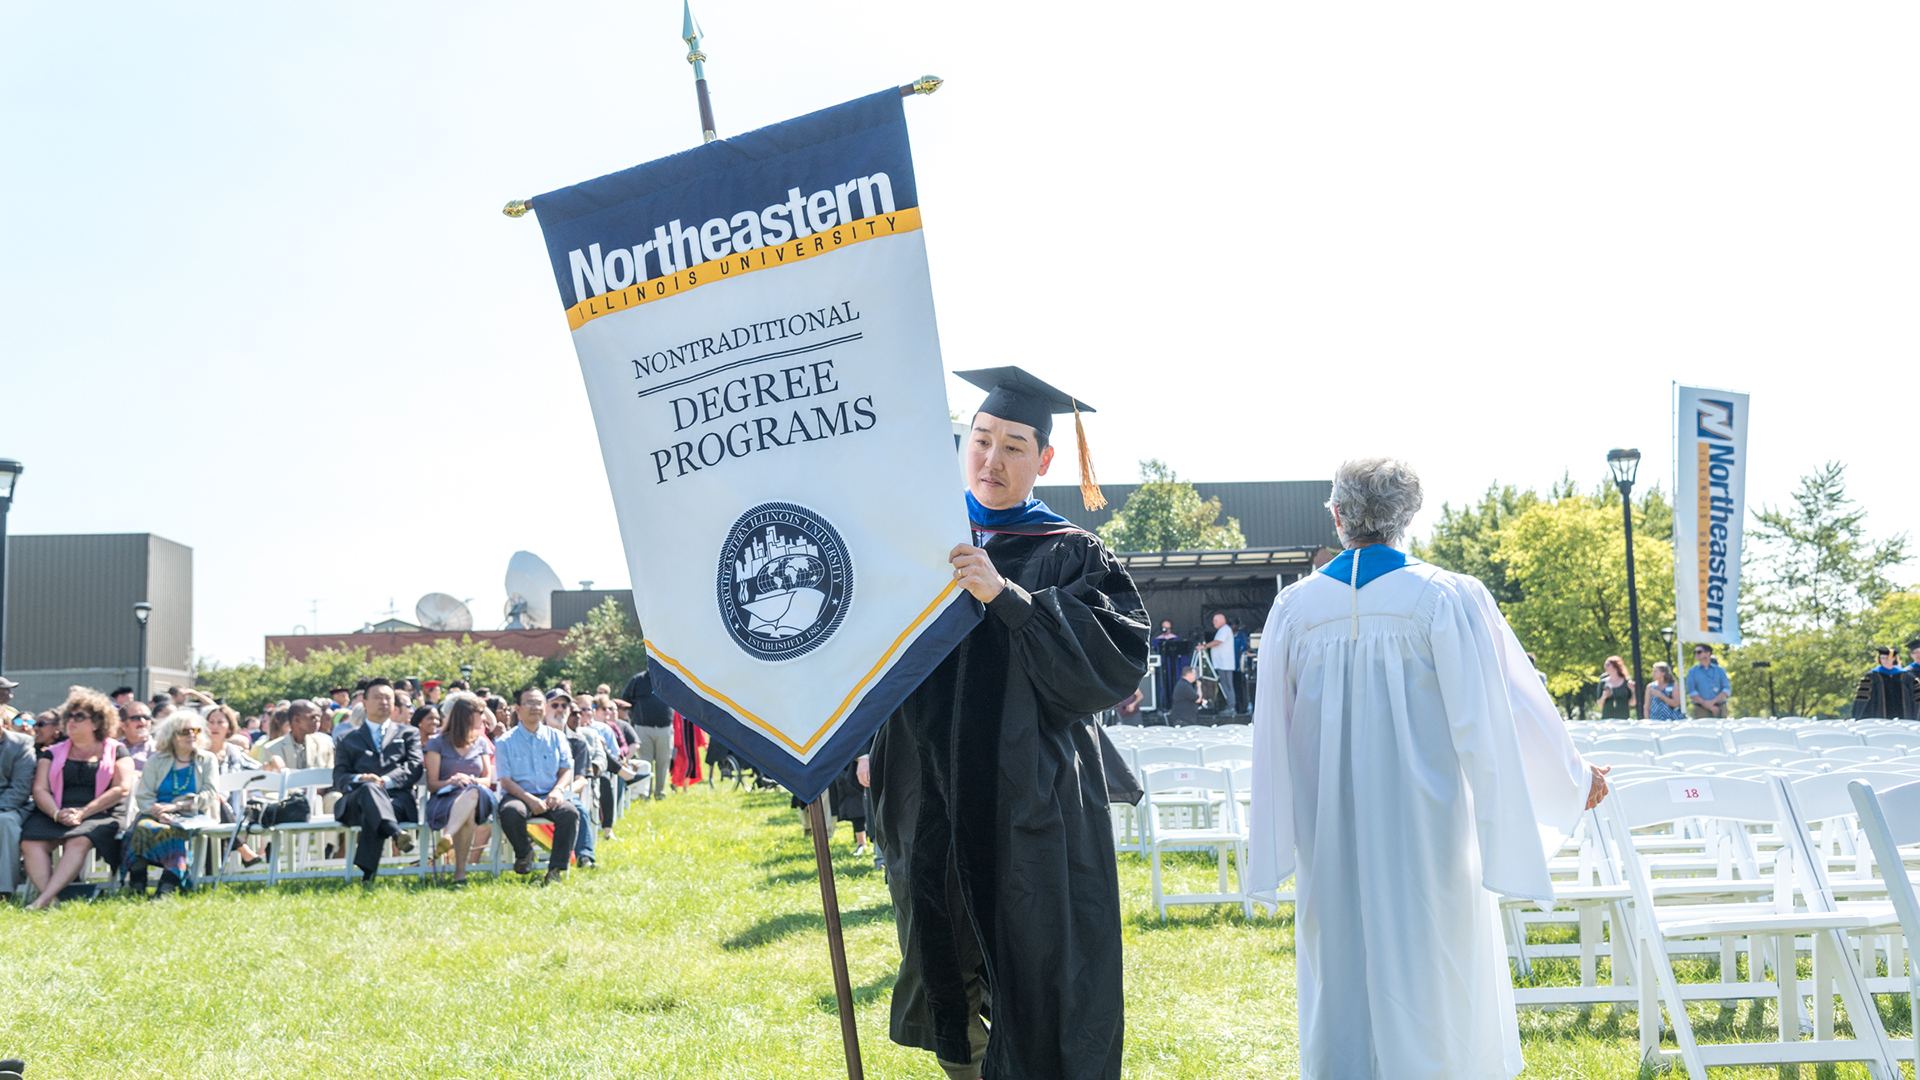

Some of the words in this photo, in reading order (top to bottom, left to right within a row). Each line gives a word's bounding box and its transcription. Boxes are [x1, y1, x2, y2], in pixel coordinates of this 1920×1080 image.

[568, 172, 896, 303] Northeastern
[578, 271, 698, 320] ILLINOIS
[720, 216, 897, 276] UNIVERSITY
[631, 301, 861, 380] NONTRADITIONAL
[650, 395, 877, 485] PROGRAMS
[669, 359, 839, 433] DEGREE
[722, 524, 750, 619] NORTHEASTERN
[750, 511, 800, 527] ILLINOIS
[803, 520, 843, 586] UNIVERSITY
[1707, 443, 1735, 634] Northeastern
[747, 635, 804, 651] ESTABLISHED
[805, 621, 824, 639] 1867
[1684, 787, 1700, 799] 18
